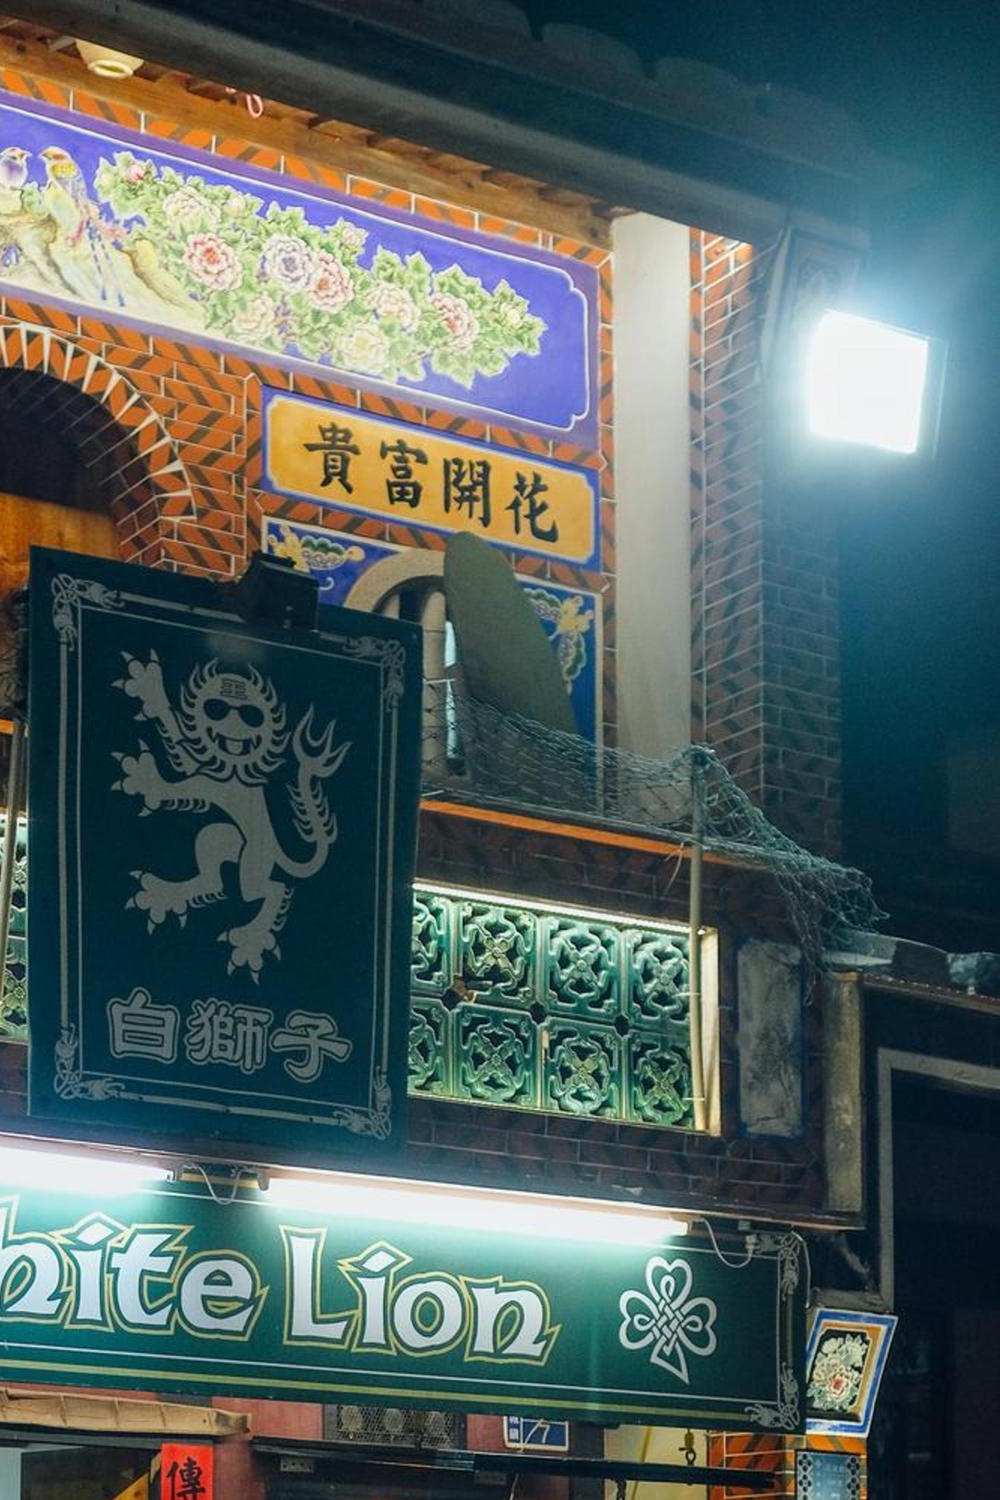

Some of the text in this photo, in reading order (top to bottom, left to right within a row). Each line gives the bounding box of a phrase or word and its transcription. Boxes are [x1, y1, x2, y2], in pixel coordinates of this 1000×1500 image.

[106, 986, 353, 1083] 白獅子
[278, 1224, 561, 1366] Lion
